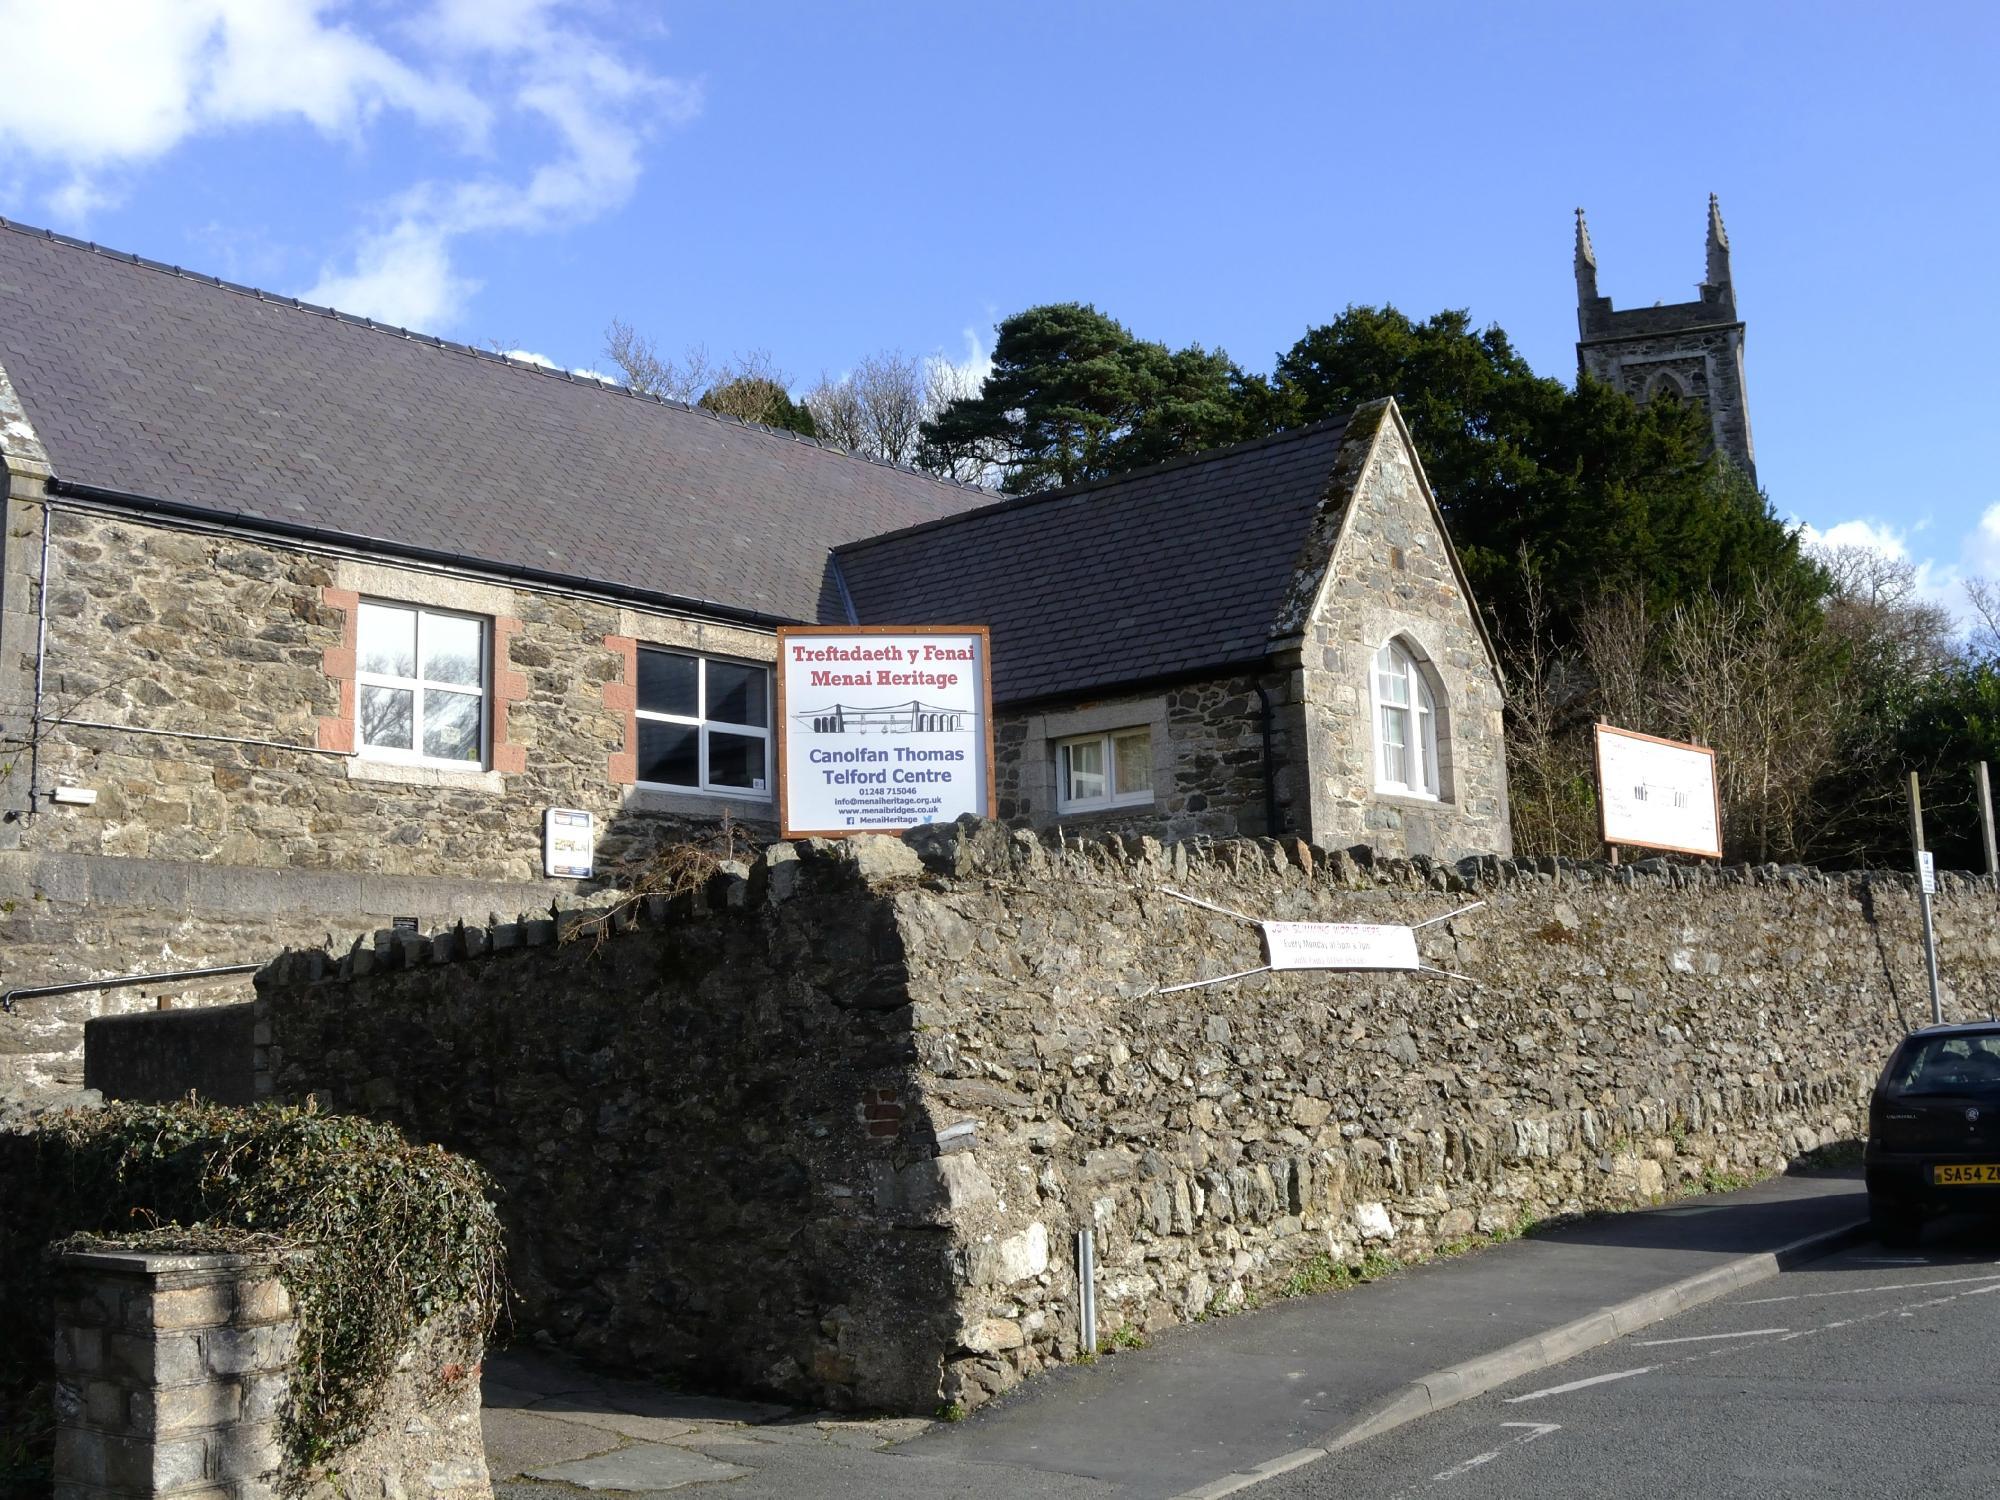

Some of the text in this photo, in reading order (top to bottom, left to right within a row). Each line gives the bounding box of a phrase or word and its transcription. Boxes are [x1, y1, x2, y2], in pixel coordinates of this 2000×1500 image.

[793, 645, 975, 664] Treftadaeth y Fenai
[811, 670, 958, 689] Menai Heritage
[809, 747, 964, 763] Canolfan Thomas
[823, 769, 952, 784] Telford Centre
[859, 787, 917, 796] 01248 715046
[834, 796, 942, 806] info@menaiheritage.org.uk
[838, 806, 939, 816] www.menaibridges.co.uk
[860, 815, 918, 825] MenaiHeritage
[1943, 1166, 2000, 1181] SA54 Z
